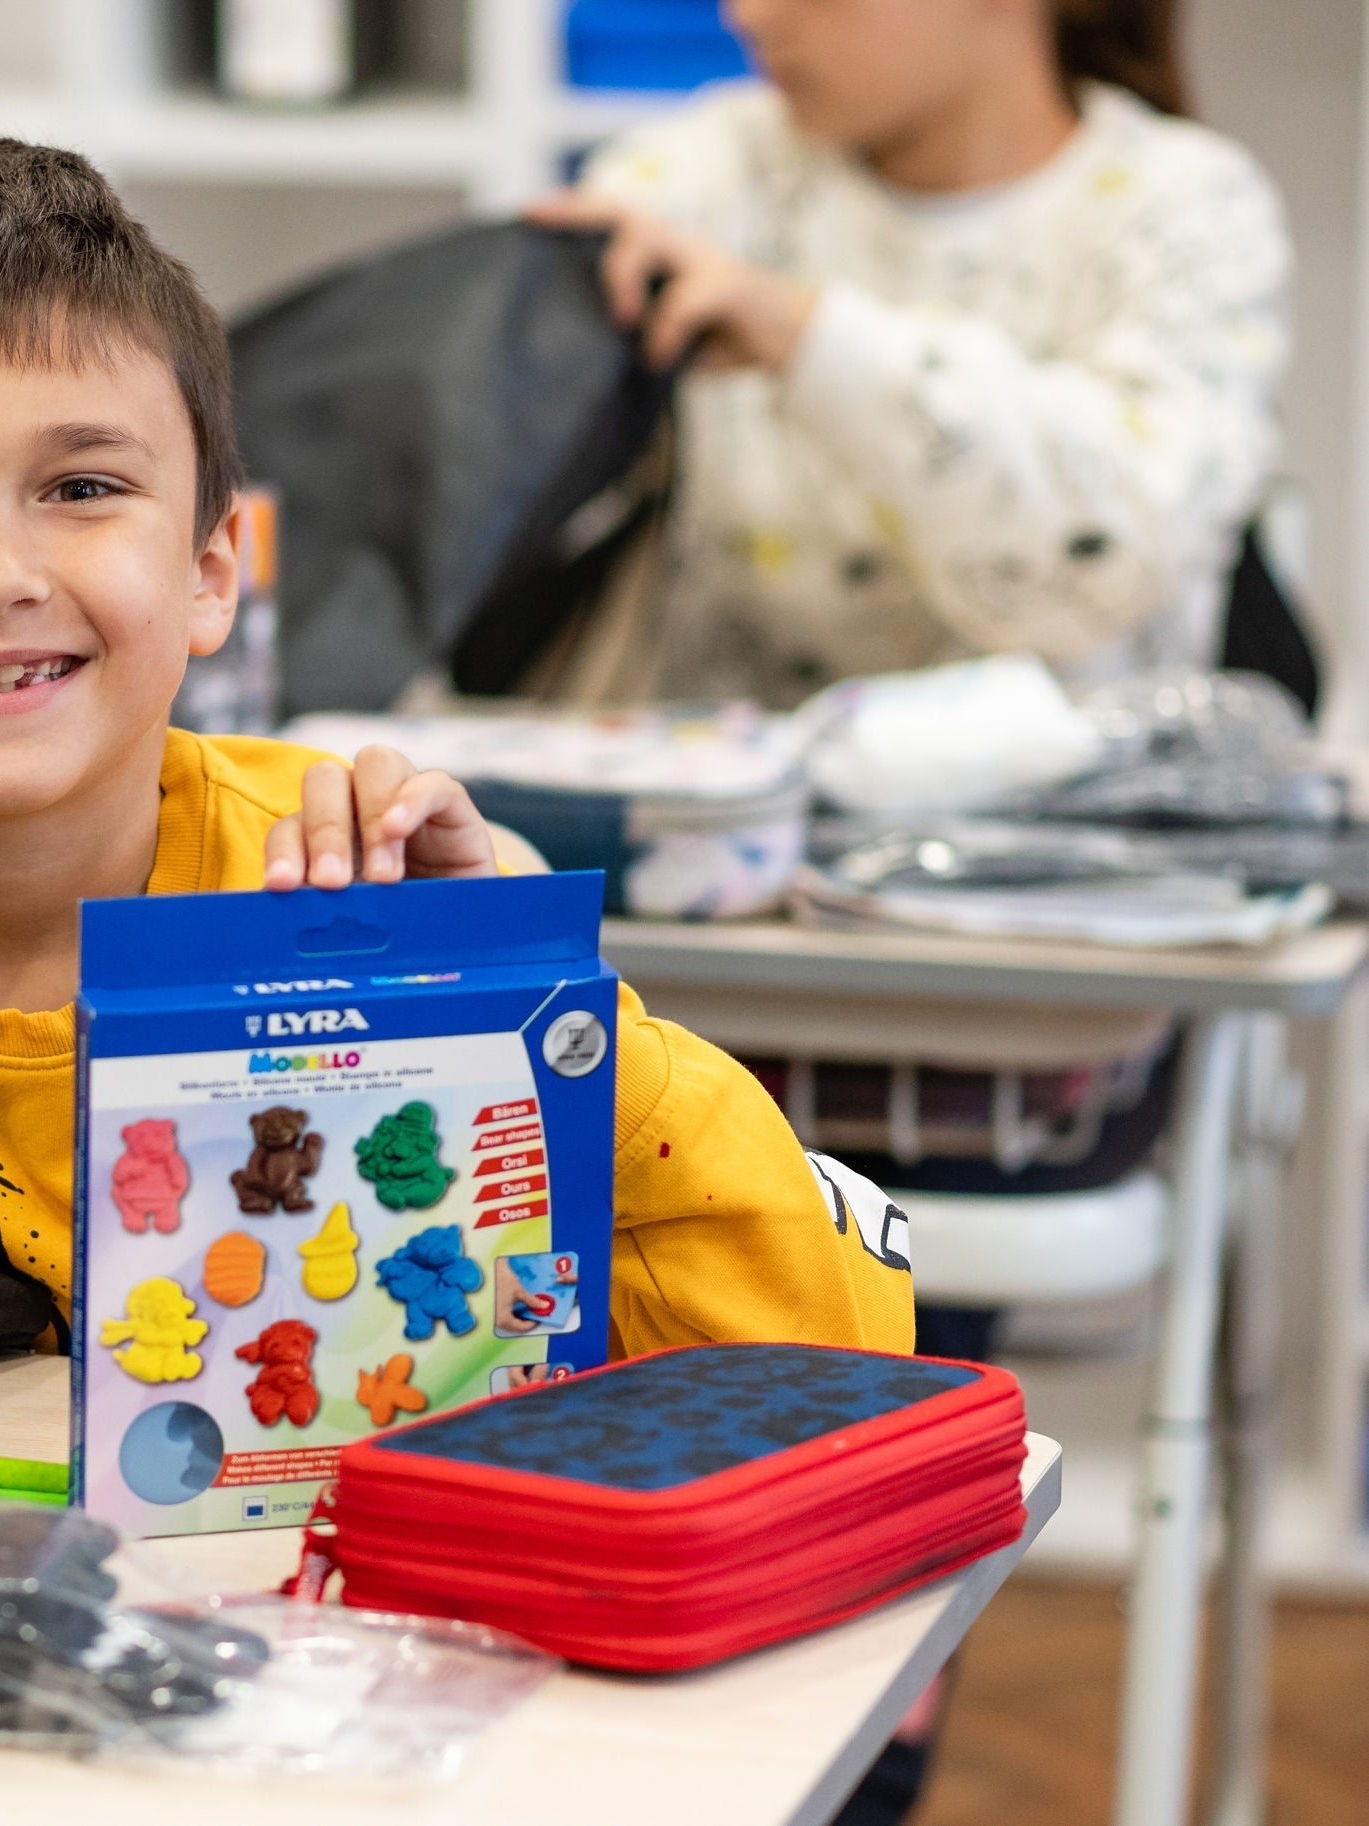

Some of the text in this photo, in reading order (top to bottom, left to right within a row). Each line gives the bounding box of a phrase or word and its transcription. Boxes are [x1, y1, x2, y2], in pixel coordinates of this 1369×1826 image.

[267, 1008, 370, 1037] LYRA
[248, 1051, 361, 1073] MODELLO
[492, 1104, 529, 1120] Bären
[501, 1154, 528, 1170] Orsi
[500, 1181, 531, 1196] Ours
[498, 1207, 531, 1222] Osos
[559, 1260, 567, 1272] 1
[556, 1369, 567, 1381] 2
